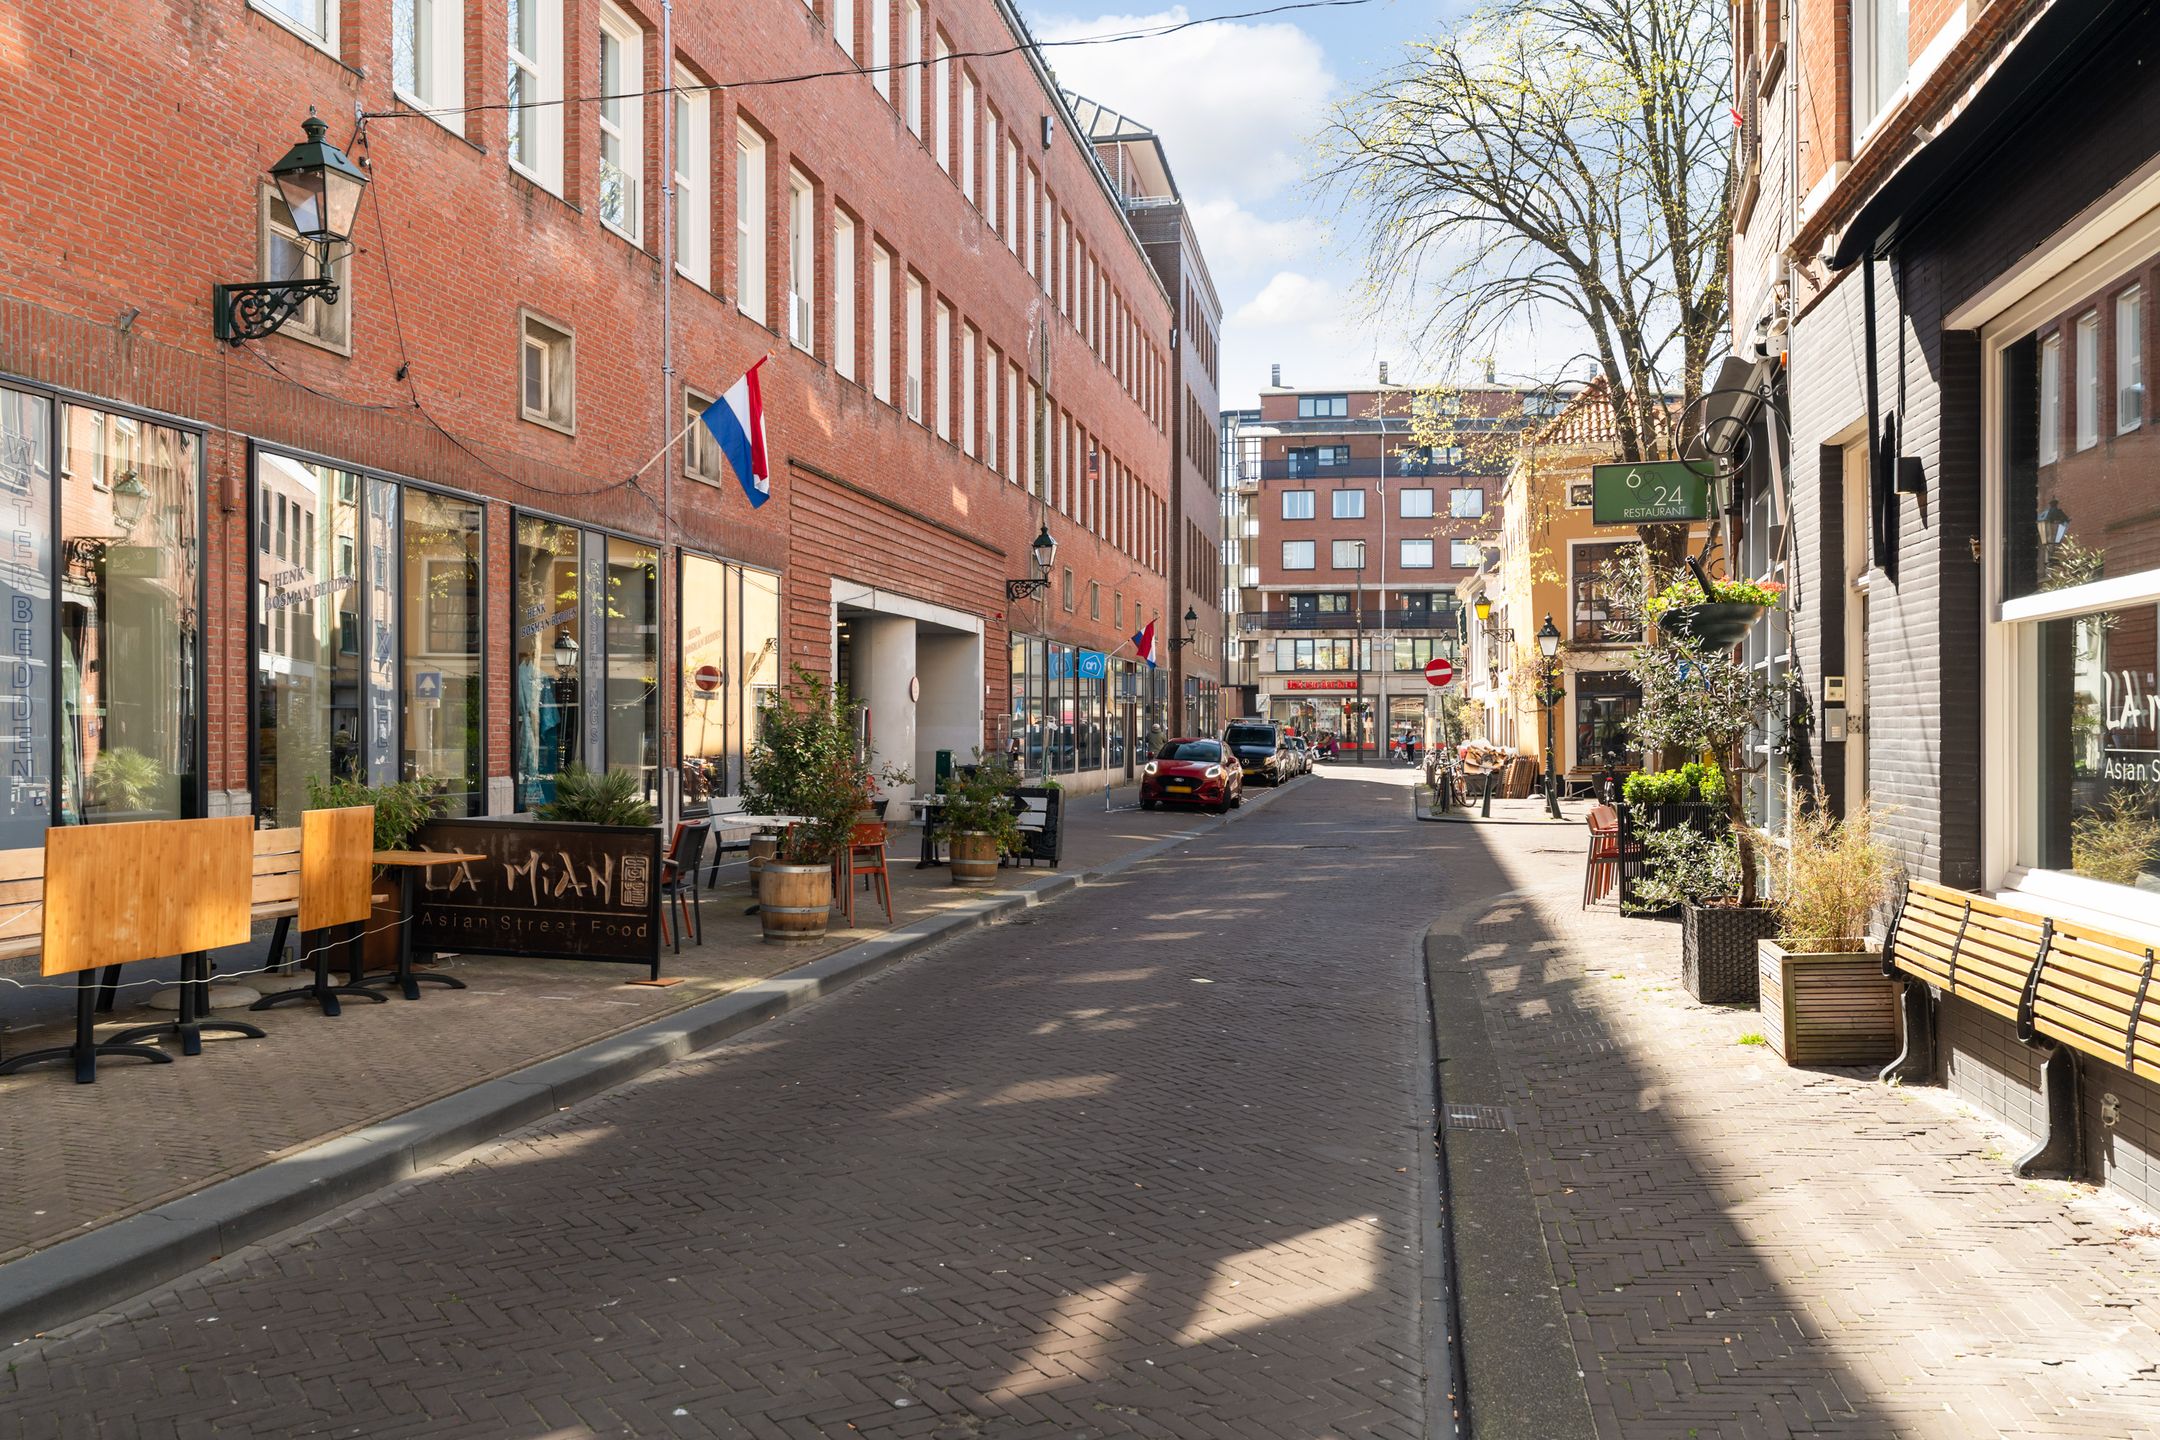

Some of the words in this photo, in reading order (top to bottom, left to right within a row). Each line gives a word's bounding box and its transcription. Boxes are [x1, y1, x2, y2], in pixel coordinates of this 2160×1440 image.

[1626, 468, 1641, 488] 6
[1653, 485, 1683, 506] 24
[1623, 506, 1687, 518] RESTAURANT
[273, 567, 305, 587] HENK
[265, 585, 311, 612] BOSMAN
[314, 574, 355, 598] BEDDEN
[7, 434, 38, 786] WATERBEDDEN
[527, 603, 546, 619] HENK
[521, 618, 550, 638] BOSMAN
[2102, 670, 2141, 731] LA
[2104, 757, 2146, 781] Asian
[420, 844, 481, 892] LA
[421, 912, 489, 929] Asian
[501, 915, 577, 933] Street
[591, 922, 648, 938] Food
